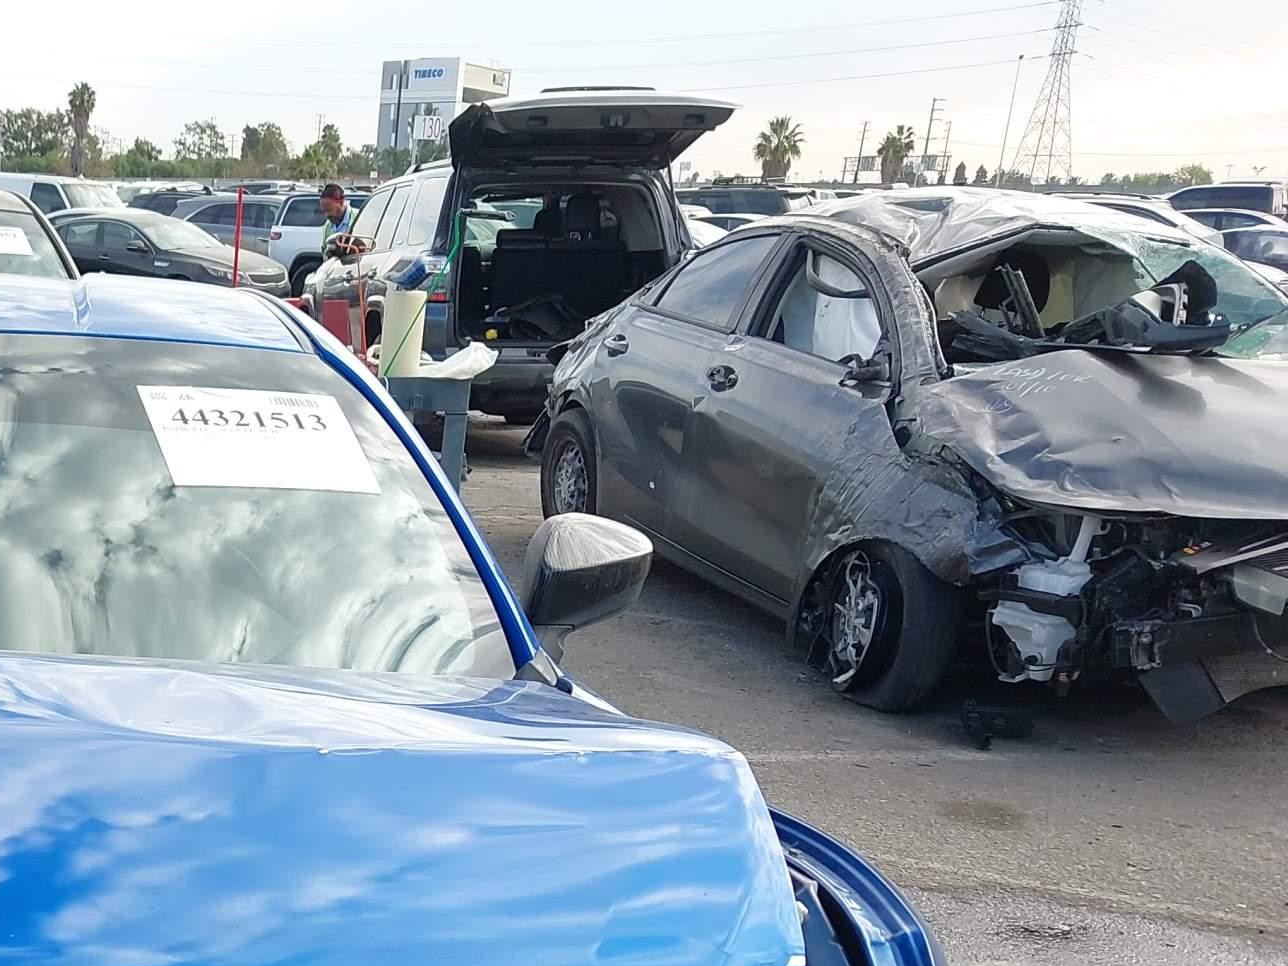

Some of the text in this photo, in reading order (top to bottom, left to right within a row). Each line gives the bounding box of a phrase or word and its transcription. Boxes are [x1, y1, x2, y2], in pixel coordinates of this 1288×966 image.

[413, 67, 444, 79] TIRECO
[422, 117, 441, 138] 130
[171, 407, 327, 432] 44321513
